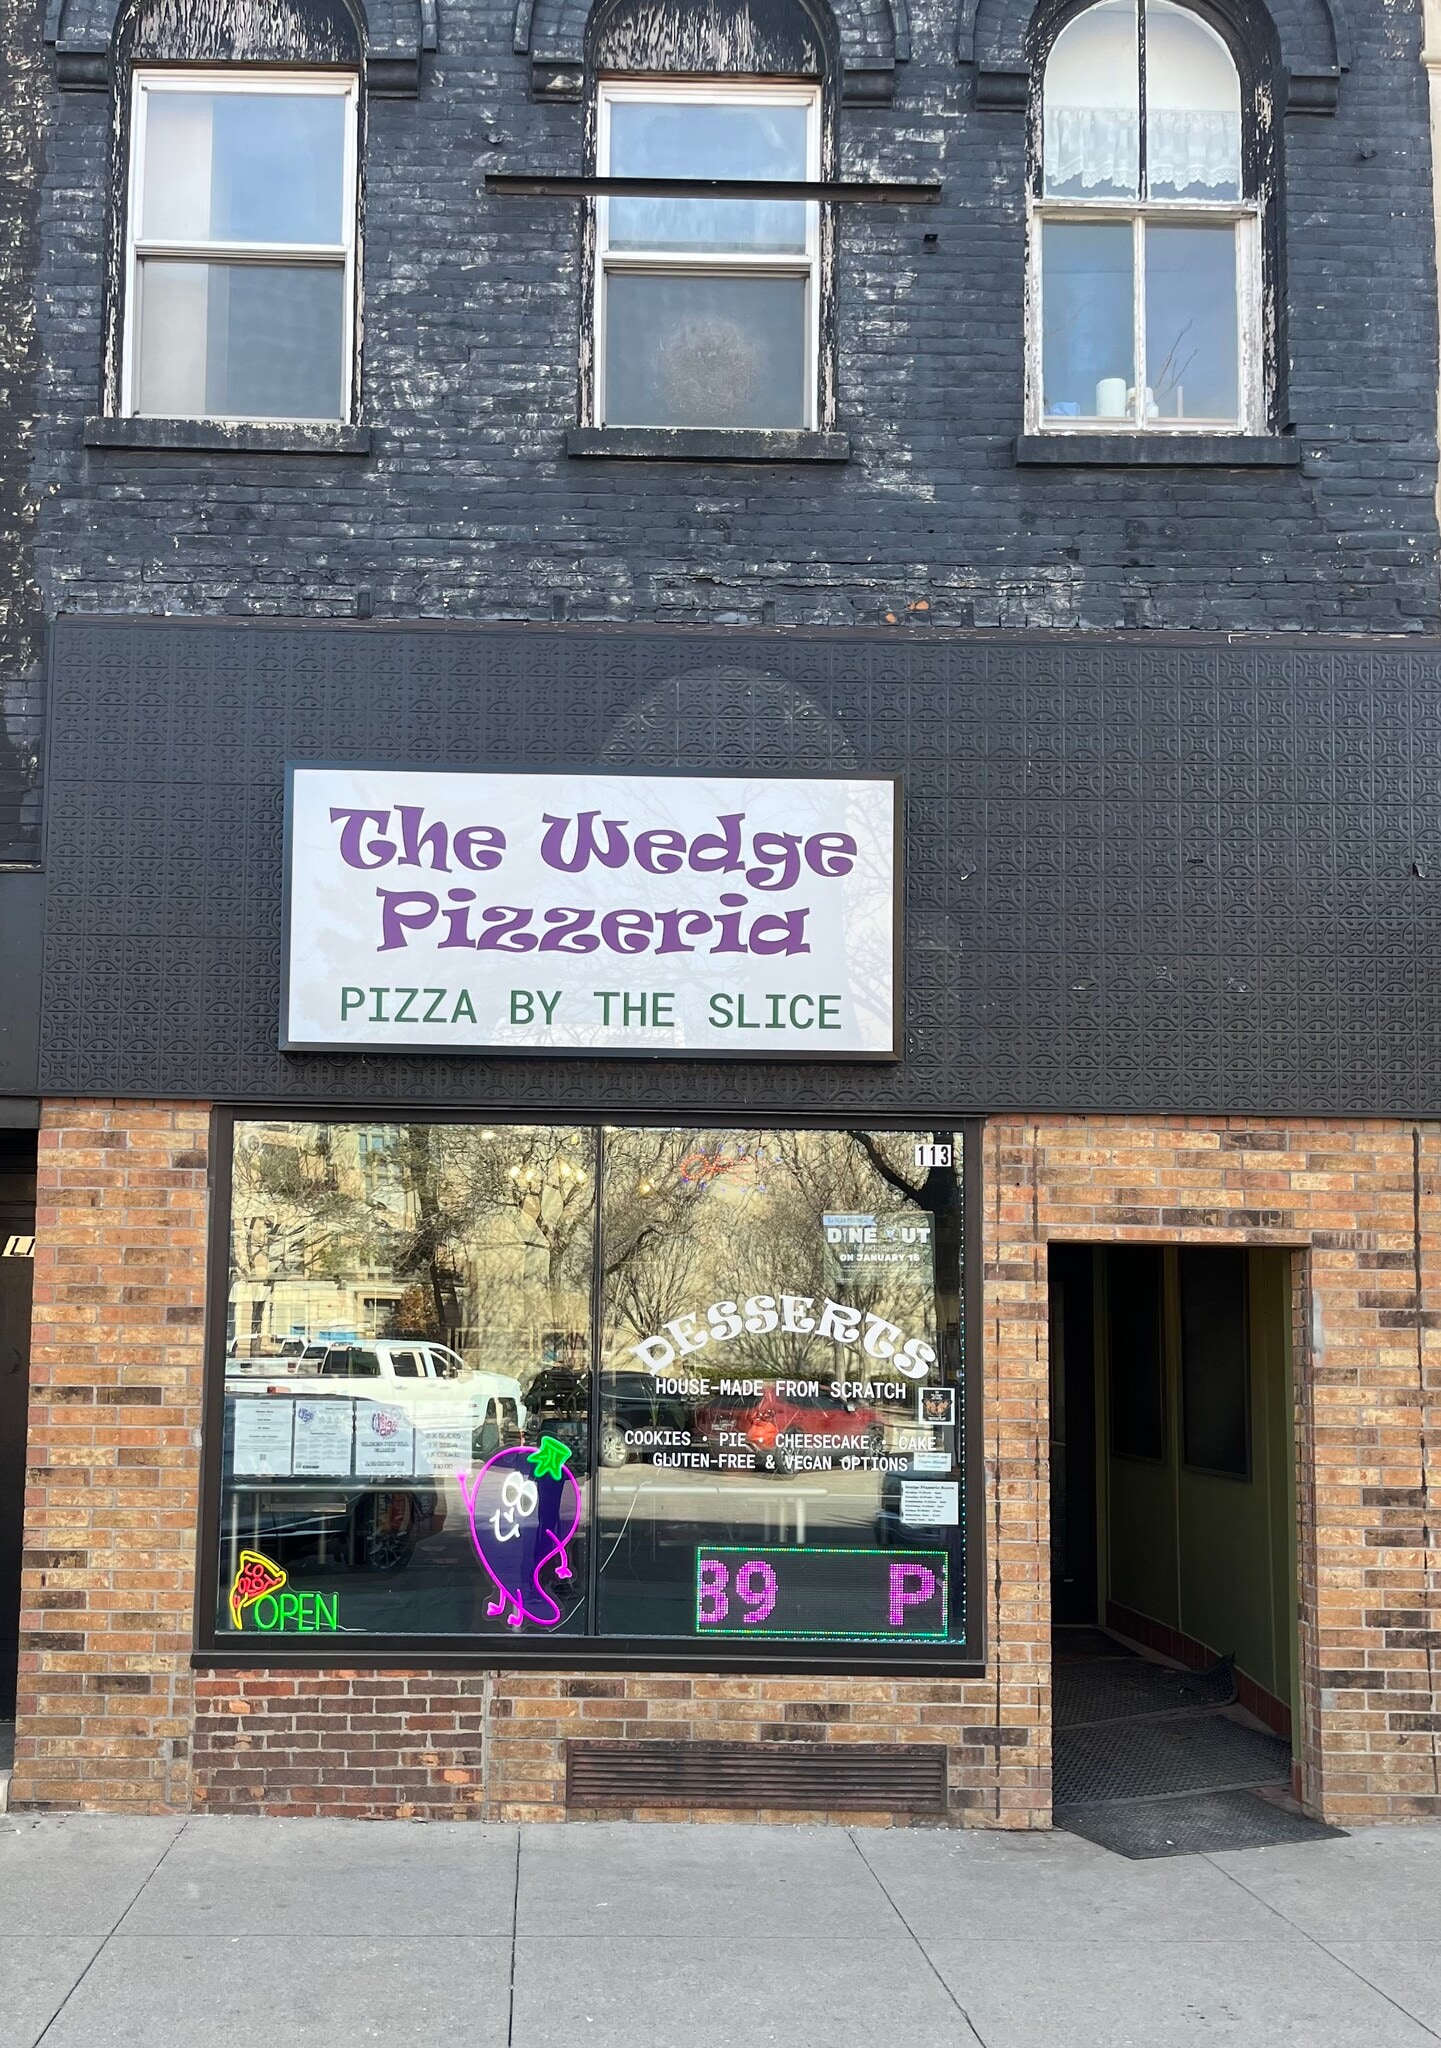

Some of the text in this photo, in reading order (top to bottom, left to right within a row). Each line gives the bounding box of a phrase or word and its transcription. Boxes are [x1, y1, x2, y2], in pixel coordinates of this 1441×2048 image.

[330, 804, 858, 891] The Wedge
[376, 886, 811, 956] Pizzeria
[340, 986, 842, 1030] PIZZA BY THE SLICE
[918, 1145, 950, 1166] 113
[827, 1227, 877, 1244] DINE
[840, 1253, 920, 1262] ON JANUARY 15
[628, 1293, 937, 1379] DESSERTS
[655, 1378, 906, 1399] HOUSE-MADE FROM SCRATCH
[624, 1430, 937, 1451] COOKIES PIE CHEESECAKE CAKE
[653, 1452, 908, 1472] GLUTEN-FREE & VEGAN OPTIONS
[254, 1592, 338, 1631] OPEN
